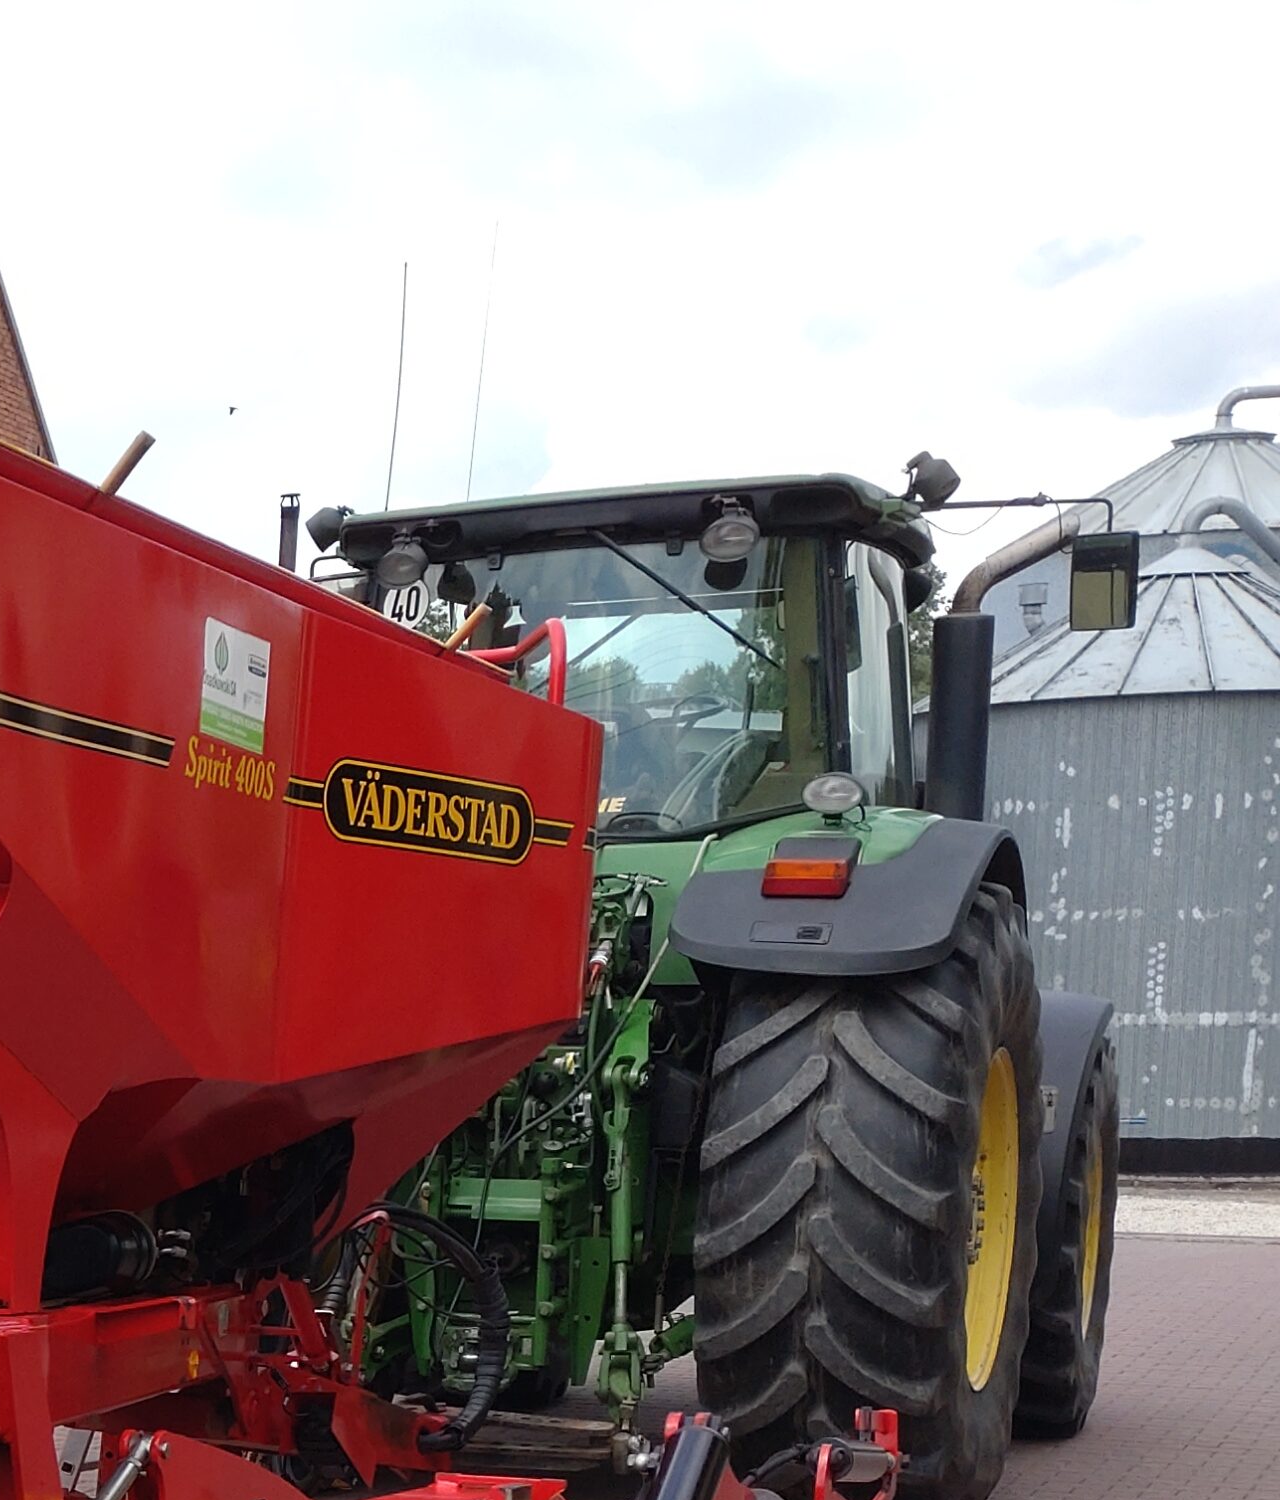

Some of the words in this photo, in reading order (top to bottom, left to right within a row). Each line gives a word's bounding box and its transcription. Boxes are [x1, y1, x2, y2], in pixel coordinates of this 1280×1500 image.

[390, 585, 421, 622] 40
[184, 735, 232, 789] Spirit
[235, 755, 276, 801] 400S
[341, 769, 521, 850] VÄDERSTAD
